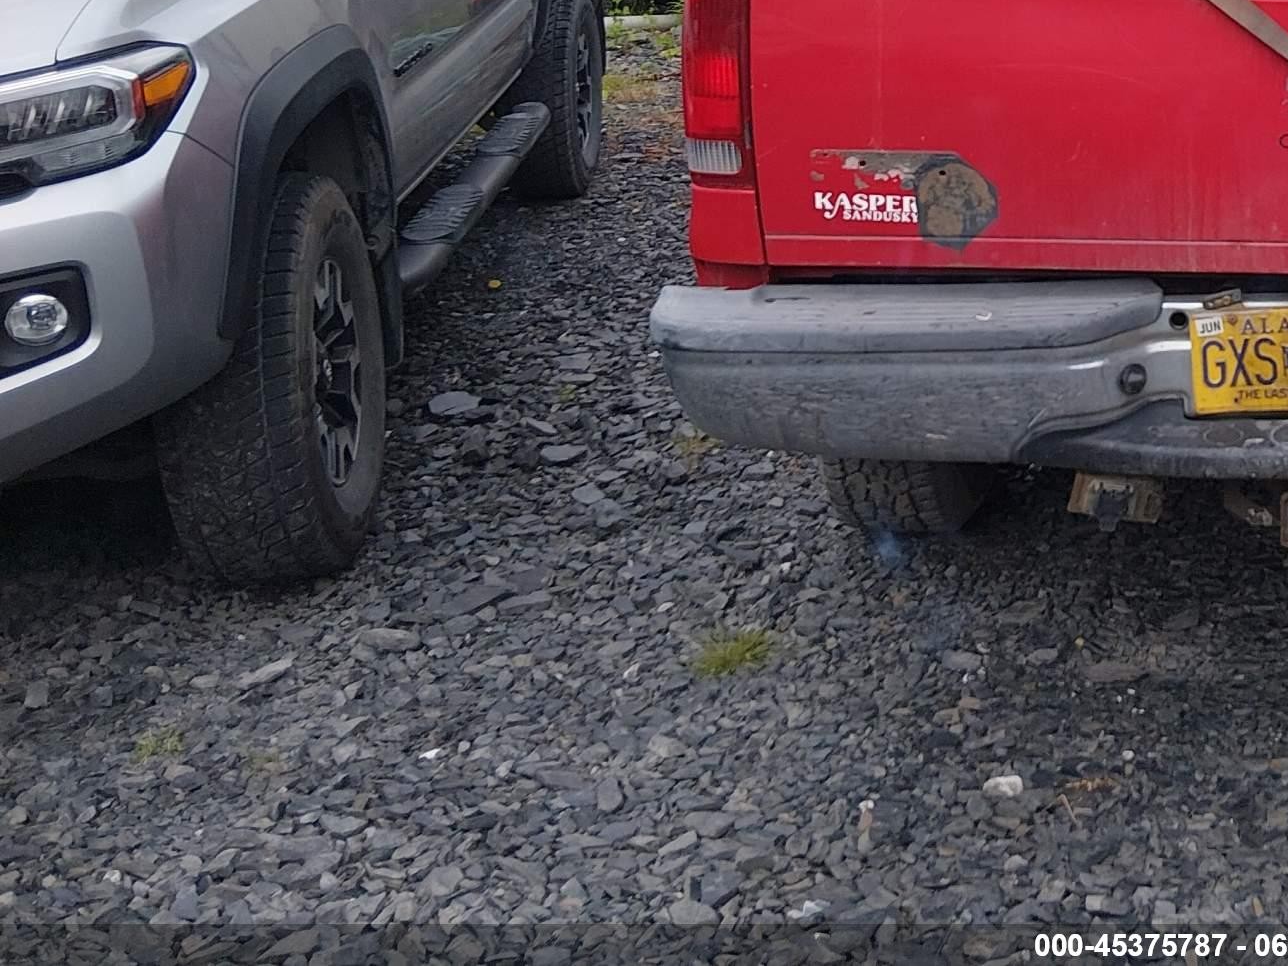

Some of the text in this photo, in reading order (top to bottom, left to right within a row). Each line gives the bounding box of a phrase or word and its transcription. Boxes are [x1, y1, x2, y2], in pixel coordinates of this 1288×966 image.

[1200, 319, 1222, 333] JUN
[1202, 337, 1279, 389] GXS
[1237, 388, 1259, 400] THE
